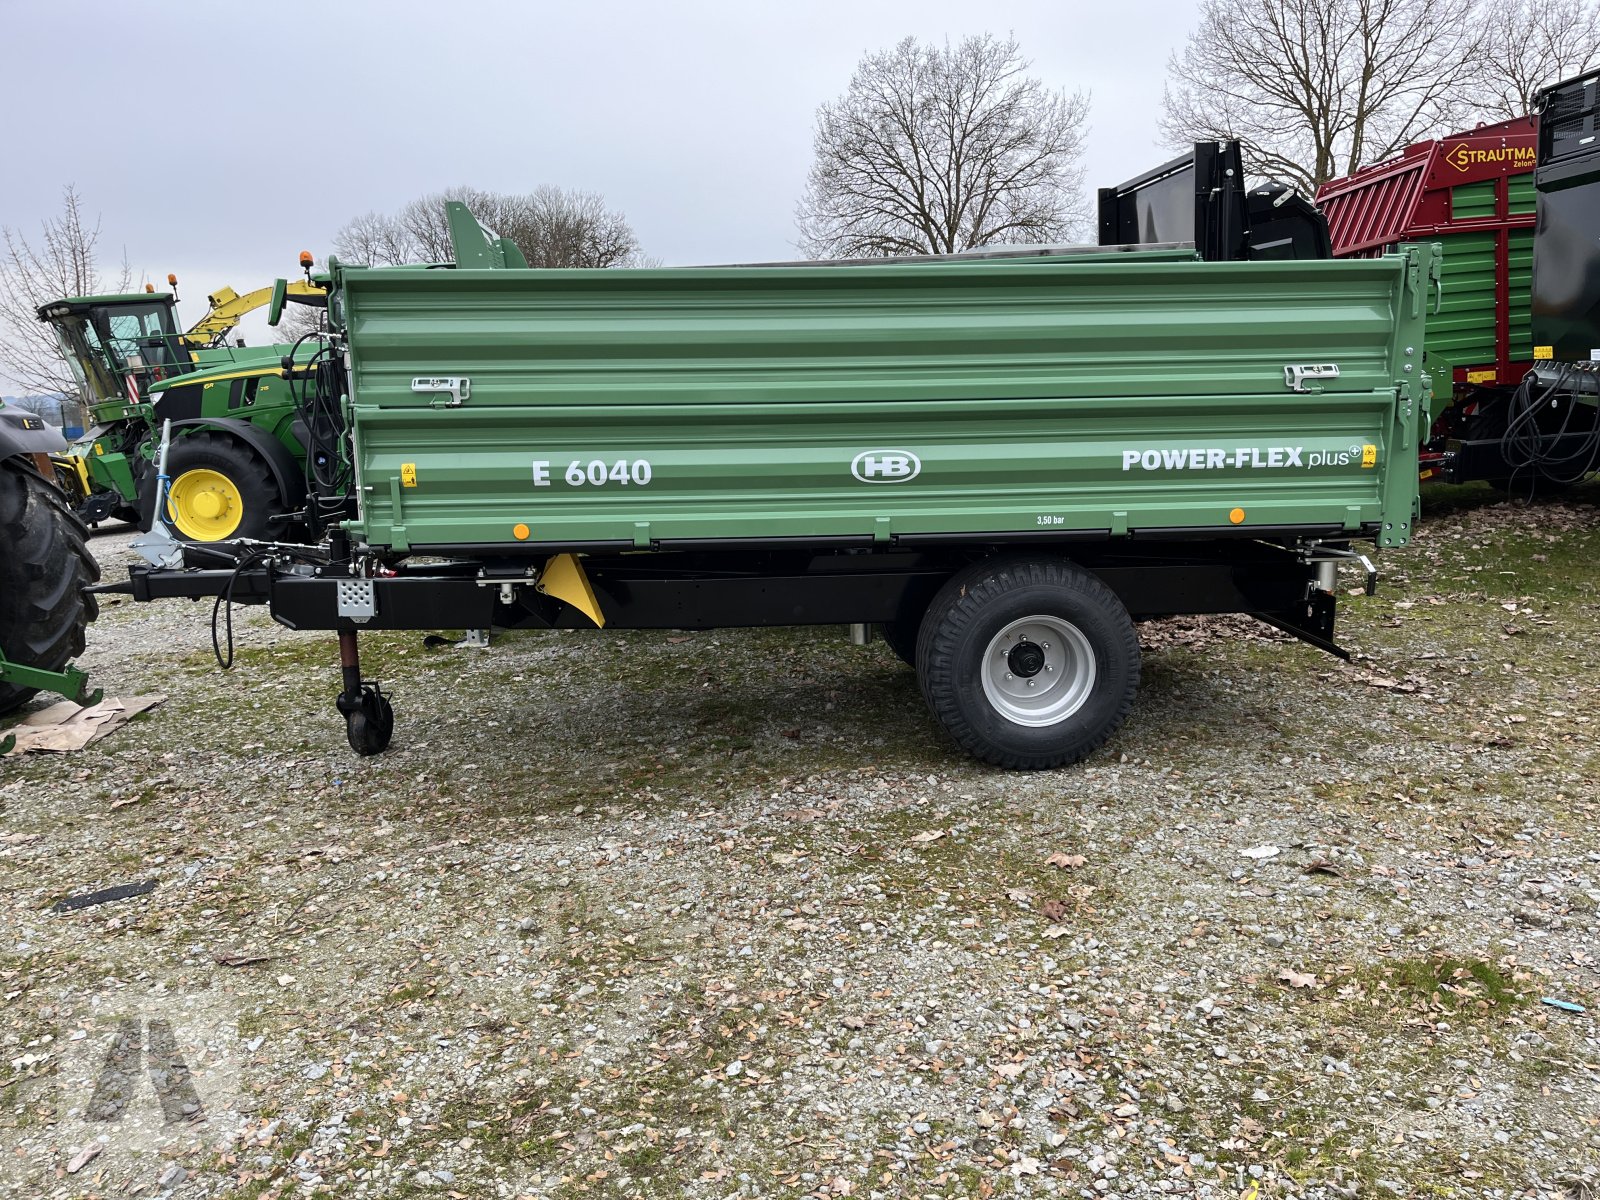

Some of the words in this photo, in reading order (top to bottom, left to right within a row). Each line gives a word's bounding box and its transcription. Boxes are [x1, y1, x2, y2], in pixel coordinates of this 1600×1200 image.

[1457, 147, 1536, 165] STRAUTMA
[864, 456, 911, 477] HB
[1122, 446, 1303, 471] POWER-FLEX
[532, 460, 551, 487] E
[564, 459, 652, 487] 6040
[1037, 515, 1052, 525] 3,50
[1053, 515, 1065, 525] bar
